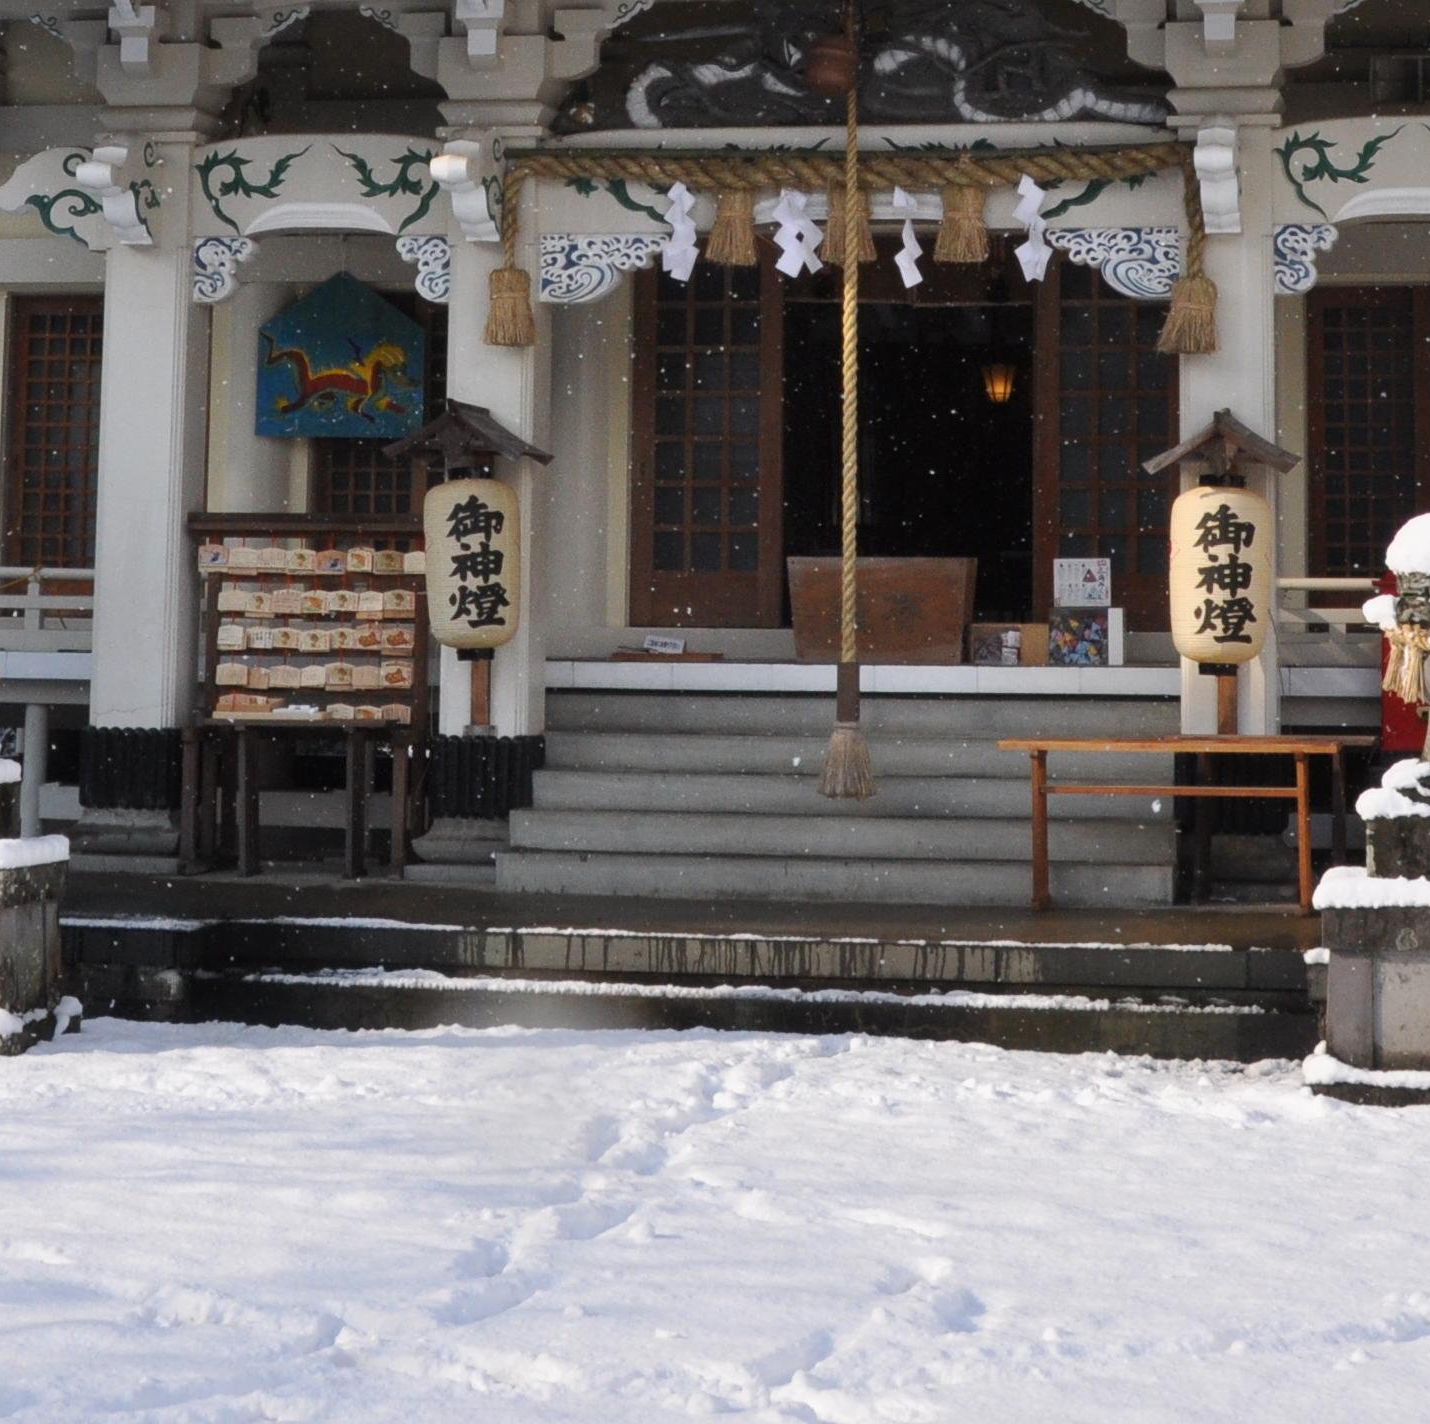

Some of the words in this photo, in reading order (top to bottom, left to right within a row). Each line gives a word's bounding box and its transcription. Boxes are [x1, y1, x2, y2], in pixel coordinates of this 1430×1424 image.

[446, 494, 510, 629] 御神燈
[1193, 503, 1257, 644] 御神燈
